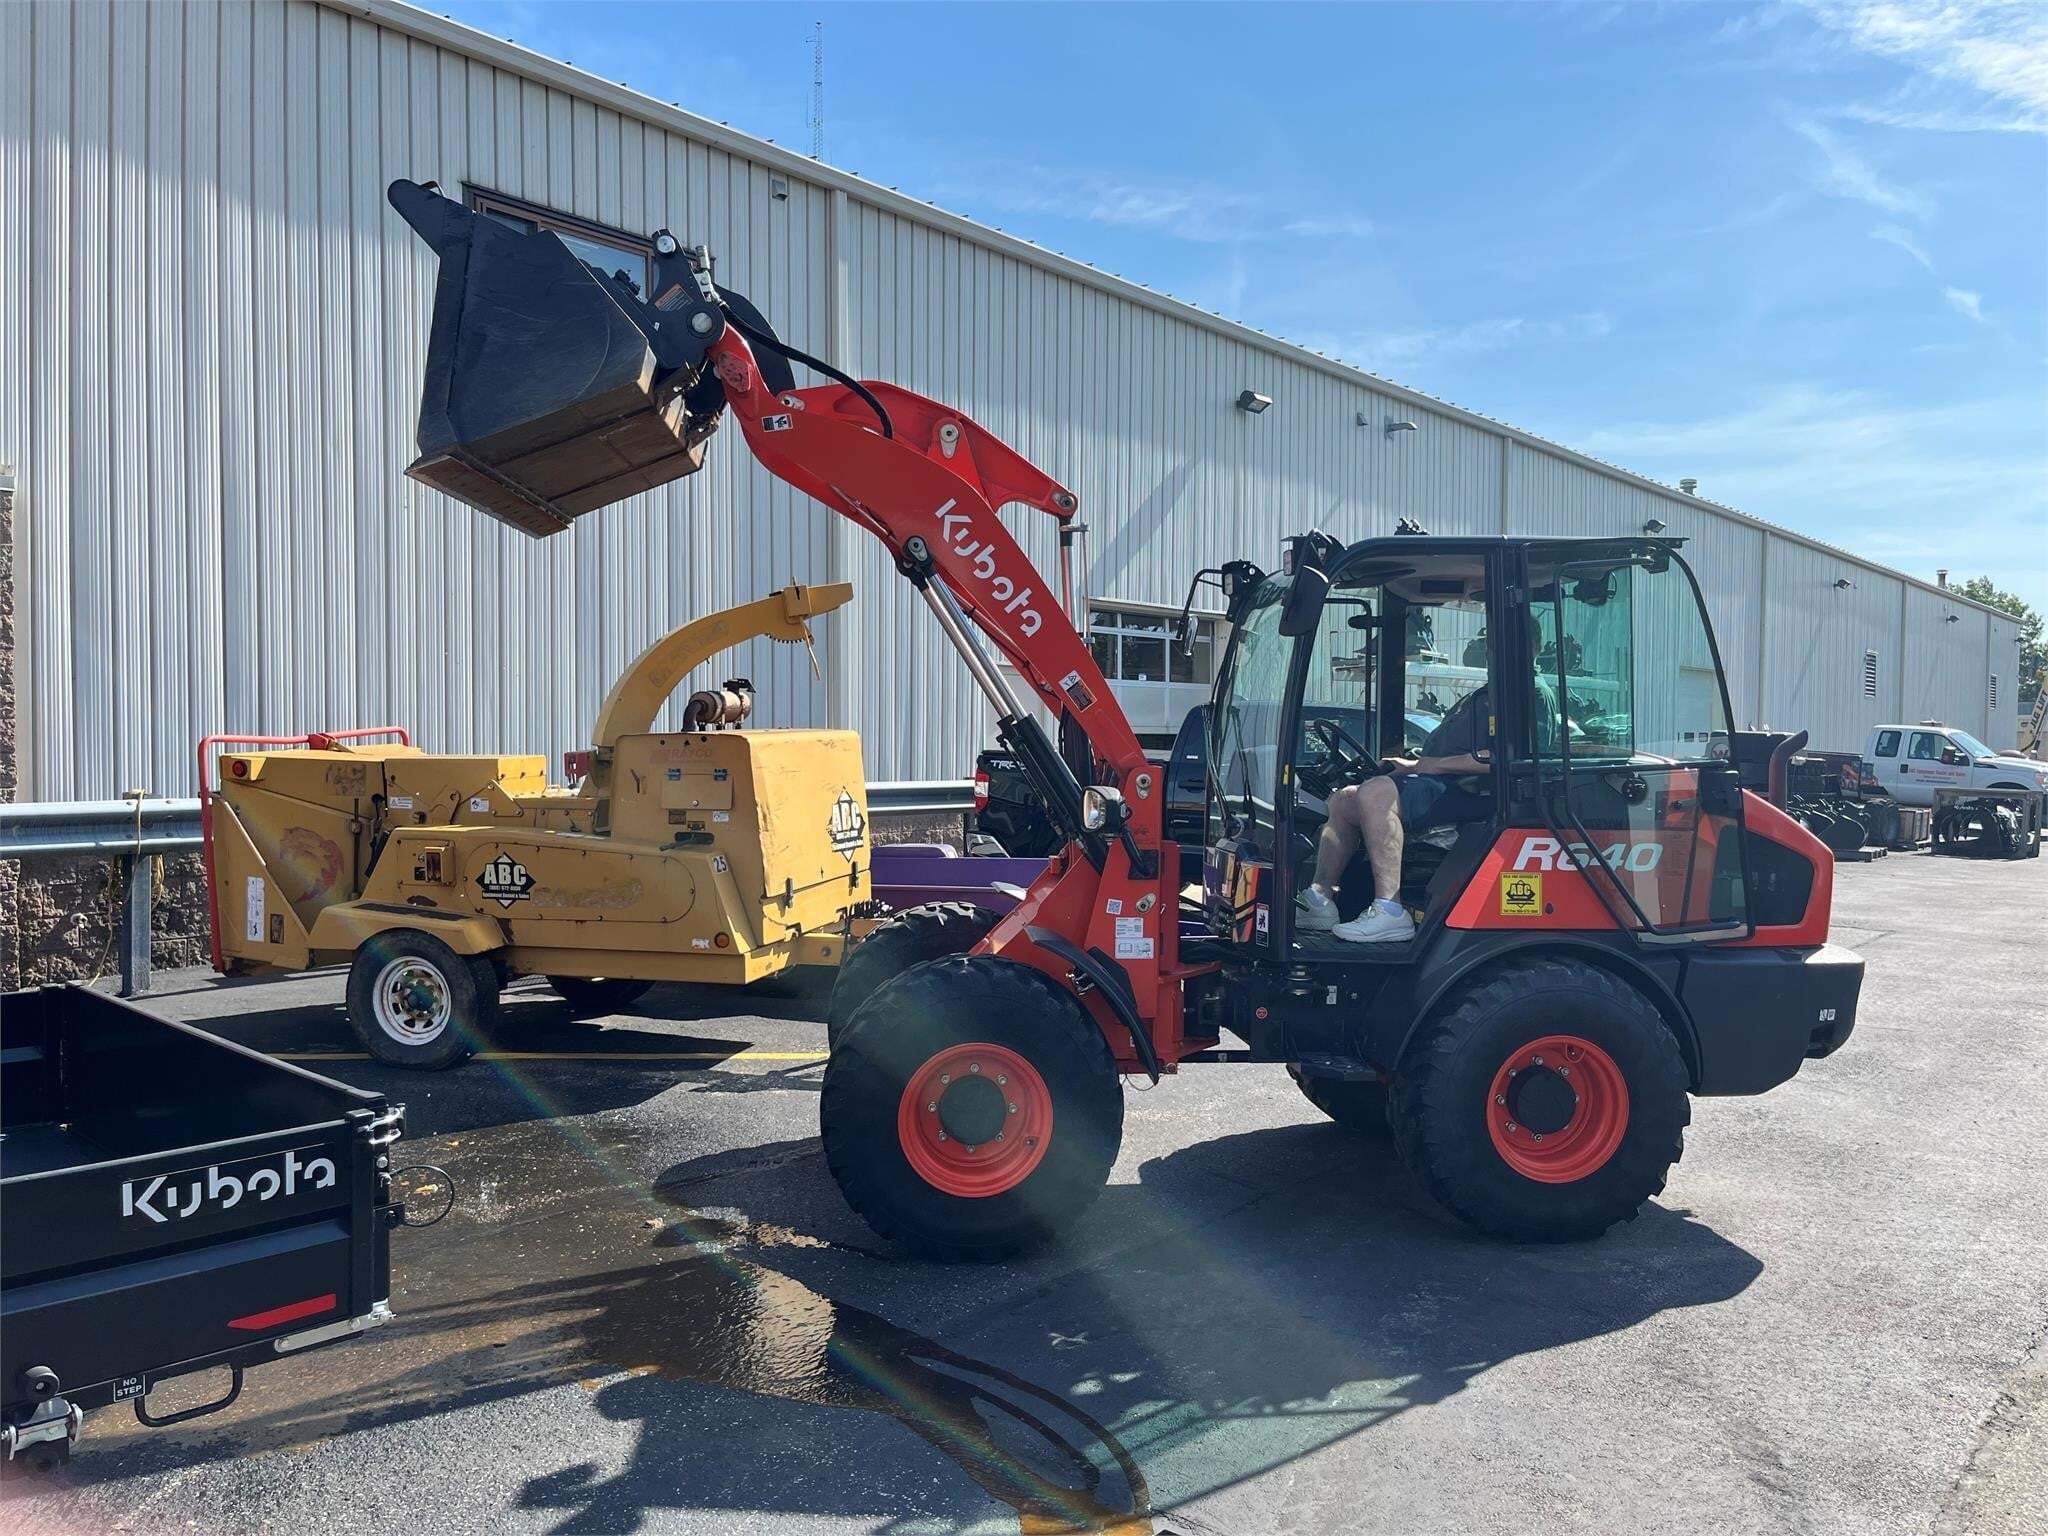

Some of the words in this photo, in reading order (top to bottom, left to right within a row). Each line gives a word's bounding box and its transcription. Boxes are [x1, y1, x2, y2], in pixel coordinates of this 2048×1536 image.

[934, 498, 1044, 638] Kubota
[832, 801, 861, 832] ABC
[714, 856, 727, 873] 25
[1512, 837, 1664, 871] R640
[484, 864, 527, 886] ABC
[1510, 884, 1532, 896] ABC
[122, 1151, 336, 1223] Kubota
[117, 1384, 142, 1397] STEP
[123, 1377, 137, 1387] NO
